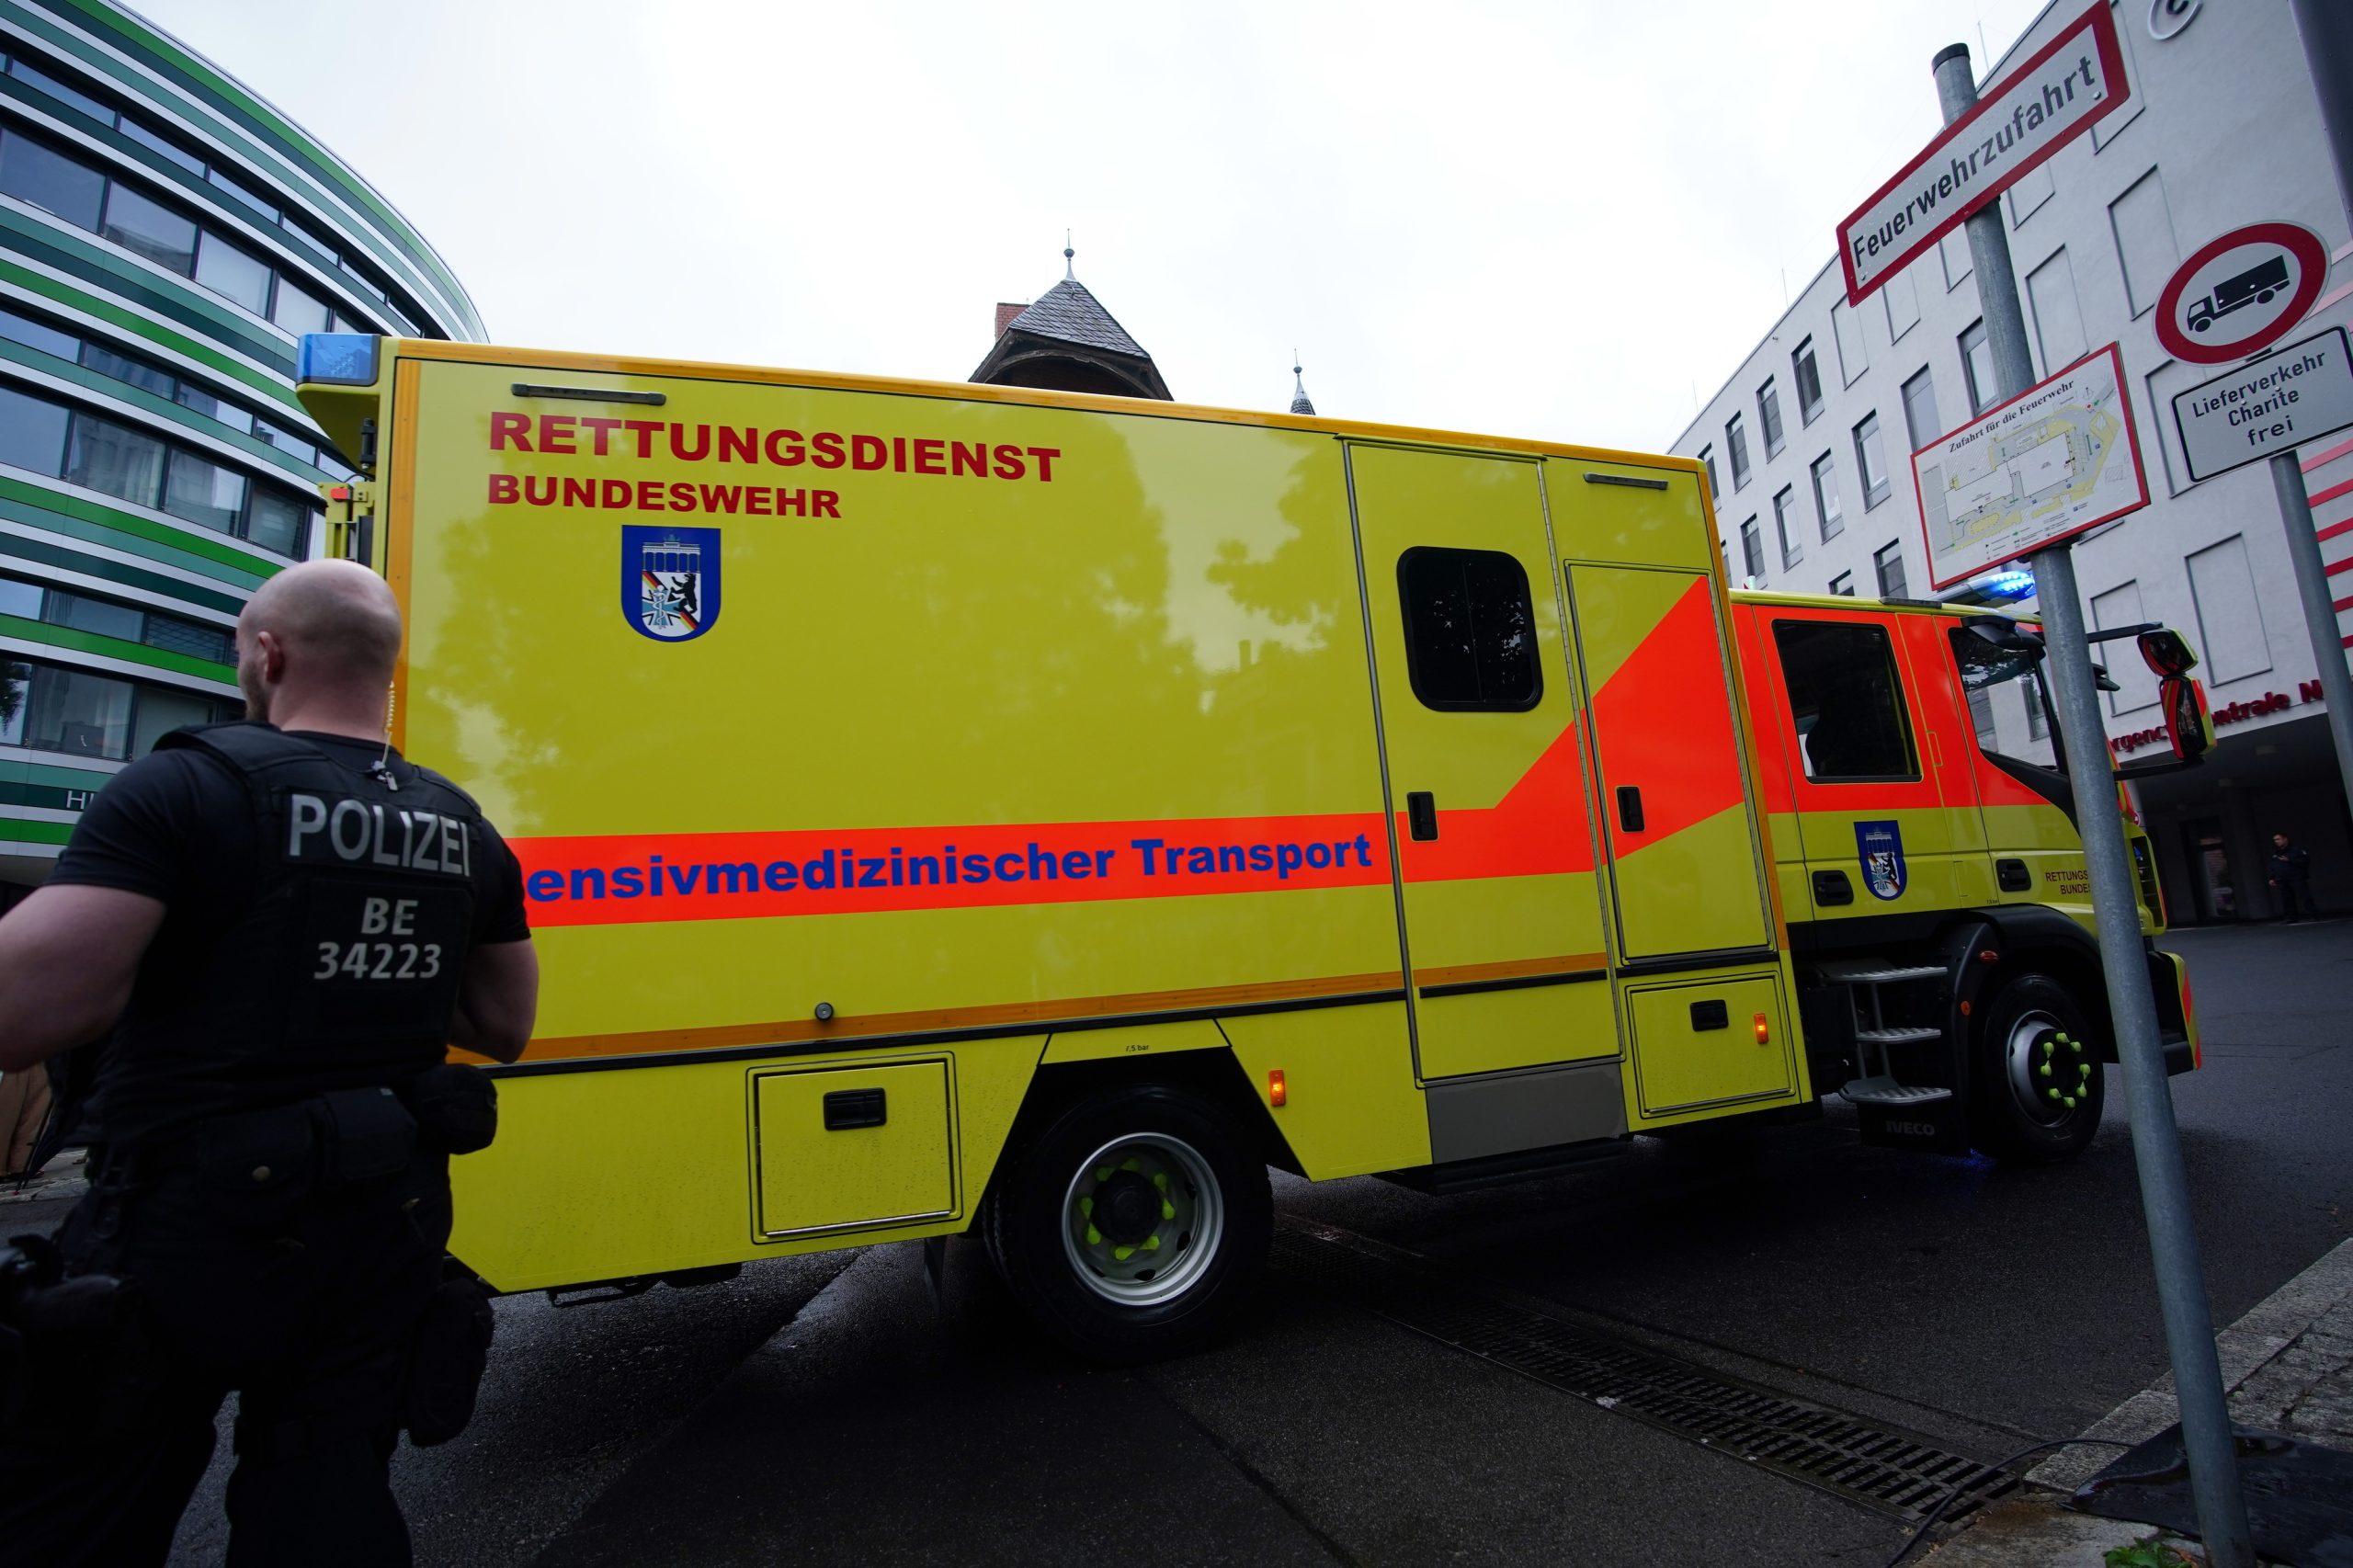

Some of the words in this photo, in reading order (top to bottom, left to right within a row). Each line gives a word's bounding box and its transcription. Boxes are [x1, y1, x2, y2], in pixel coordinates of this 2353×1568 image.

[1852, 55, 2097, 268] Feuerwehrzufahrt
[2192, 352, 2325, 418] Lieferverkehr
[1949, 430, 1984, 453] Zufahrt
[1985, 420, 2000, 434] für
[2002, 410, 2018, 425] die
[2019, 380, 2075, 415] Feuerwehr
[2228, 390, 2300, 426] Charite
[489, 411, 1062, 483] RETTUNGSDIENST
[2247, 415, 2293, 446] frei
[488, 474, 842, 519] BUNDESWEHR
[290, 793, 471, 876] POLIZEI
[527, 842, 1115, 902] ensivmedizinischer
[1131, 834, 1372, 880] Transport
[2045, 869, 2089, 882] RETTUNGS
[2060, 883, 2091, 895] BUNDE
[360, 897, 419, 936] BE
[313, 942, 441, 980] 34223
[1885, 1119, 1936, 1136] IVECO
